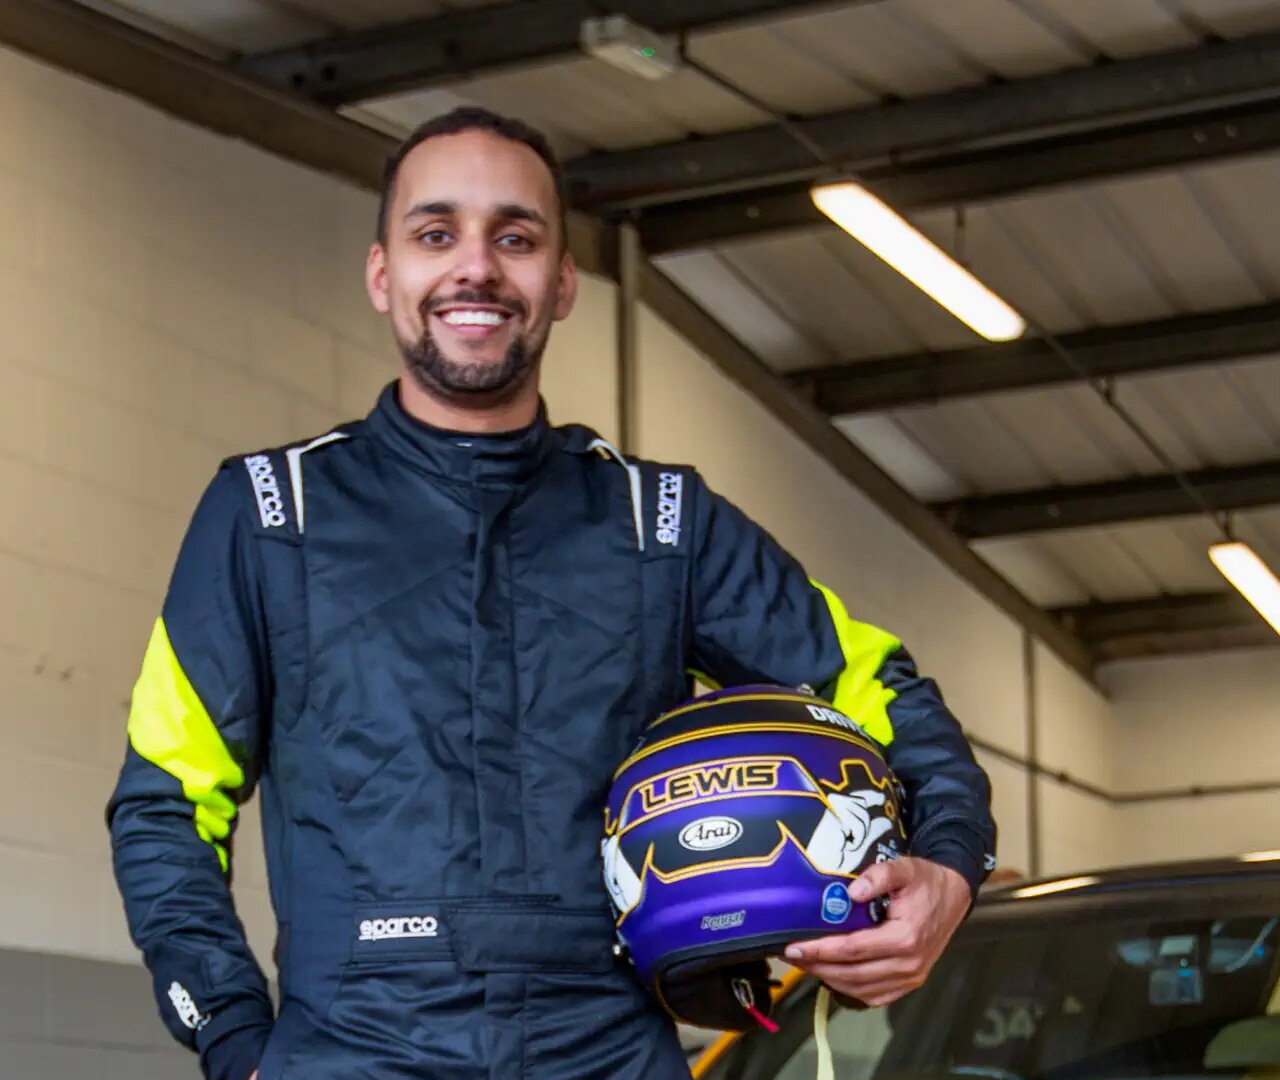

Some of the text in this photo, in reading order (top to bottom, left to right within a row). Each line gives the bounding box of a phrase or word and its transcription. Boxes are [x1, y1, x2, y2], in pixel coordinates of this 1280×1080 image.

[244, 455, 286, 528] sparco
[656, 472, 682, 546] sparco
[641, 763, 780, 812] LEWIS
[686, 820, 732, 844] Arai
[359, 916, 438, 940] sparco
